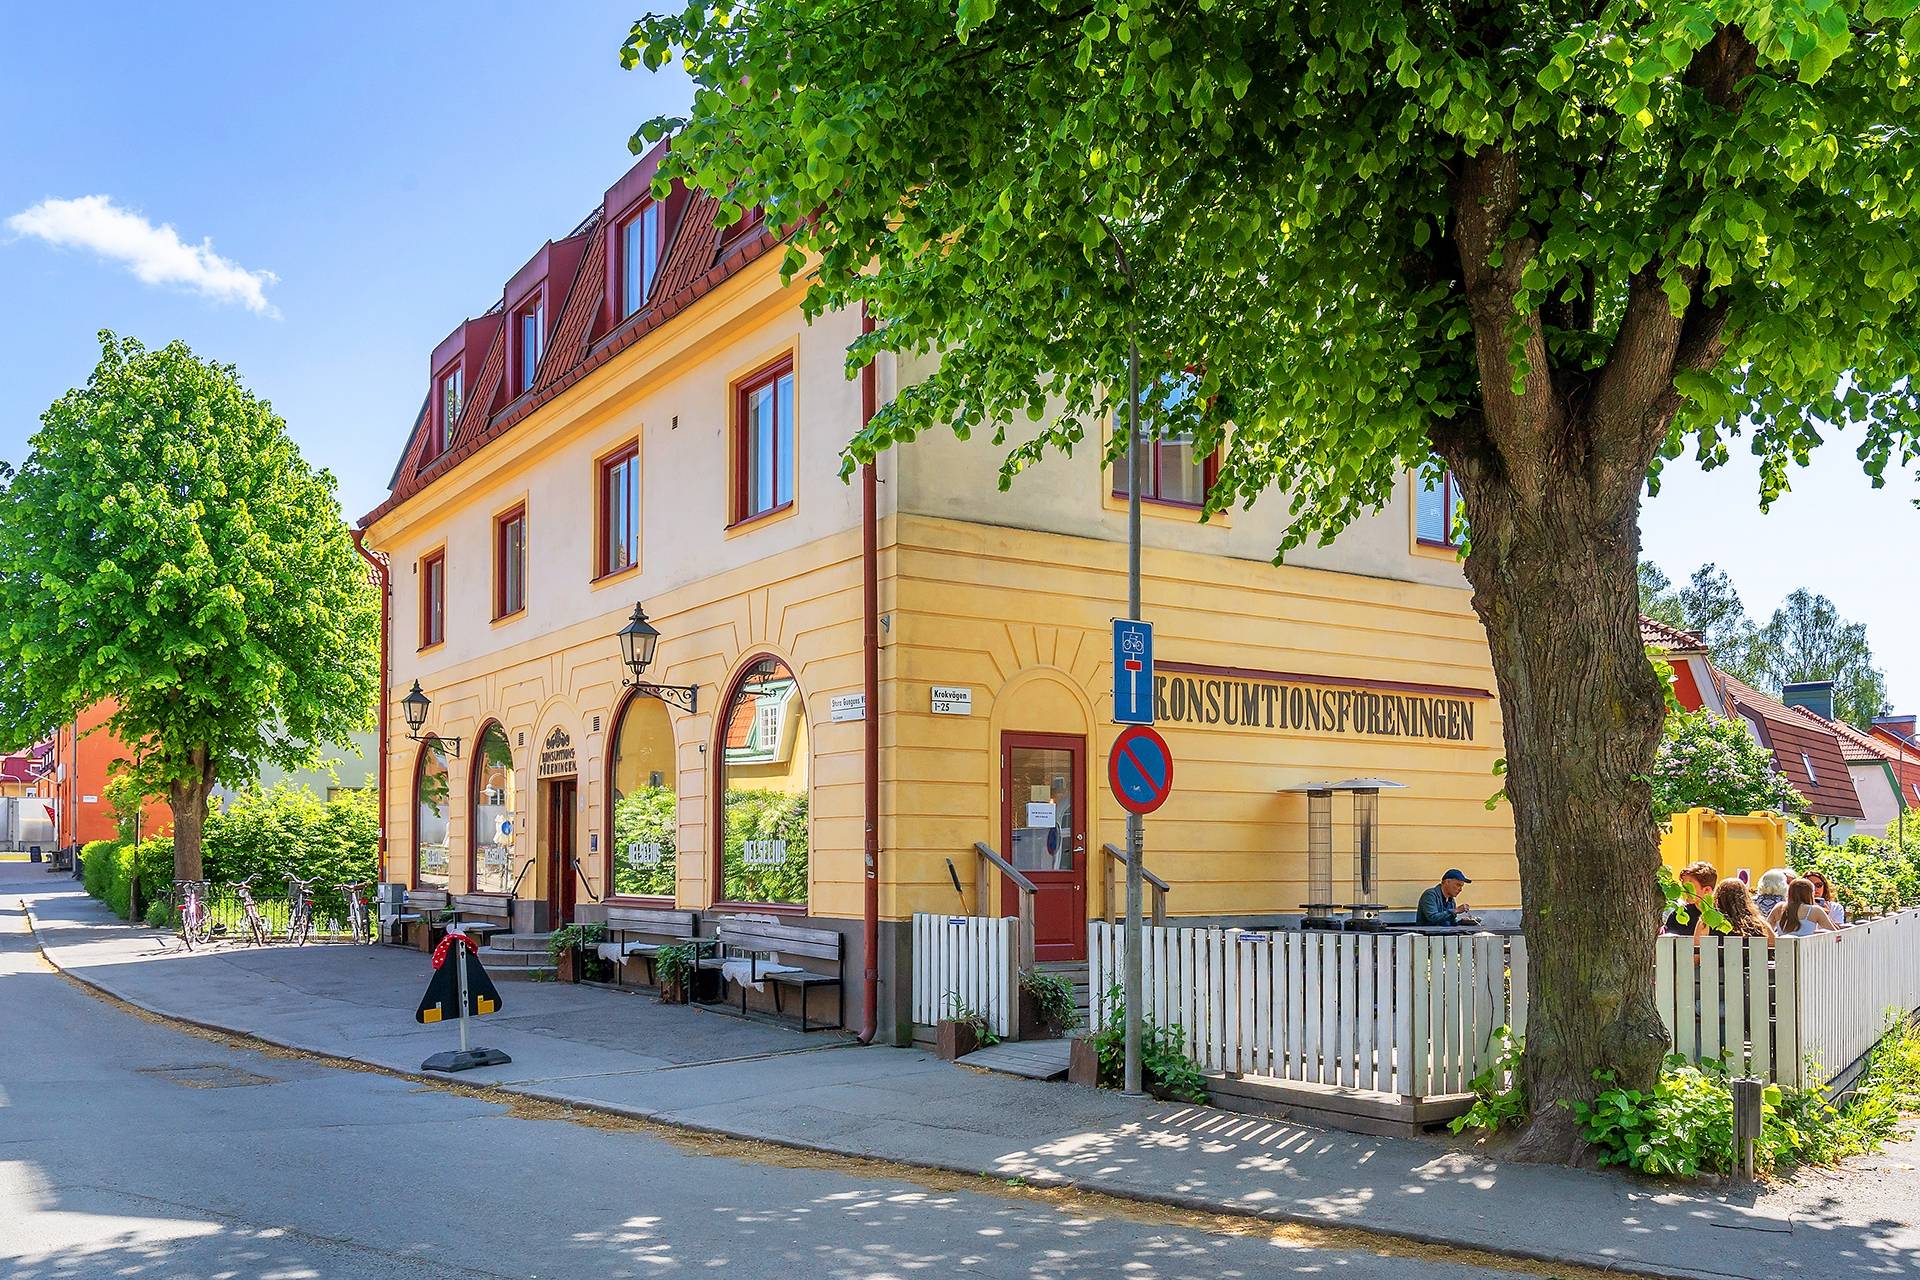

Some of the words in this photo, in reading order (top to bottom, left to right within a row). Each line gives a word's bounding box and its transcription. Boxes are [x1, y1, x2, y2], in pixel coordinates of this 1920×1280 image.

[934, 689, 967, 701] Krokvägen
[934, 702, 950, 712] 1-25
[1154, 675, 1474, 740] KONSUMTIONSFÖRENINGEN
